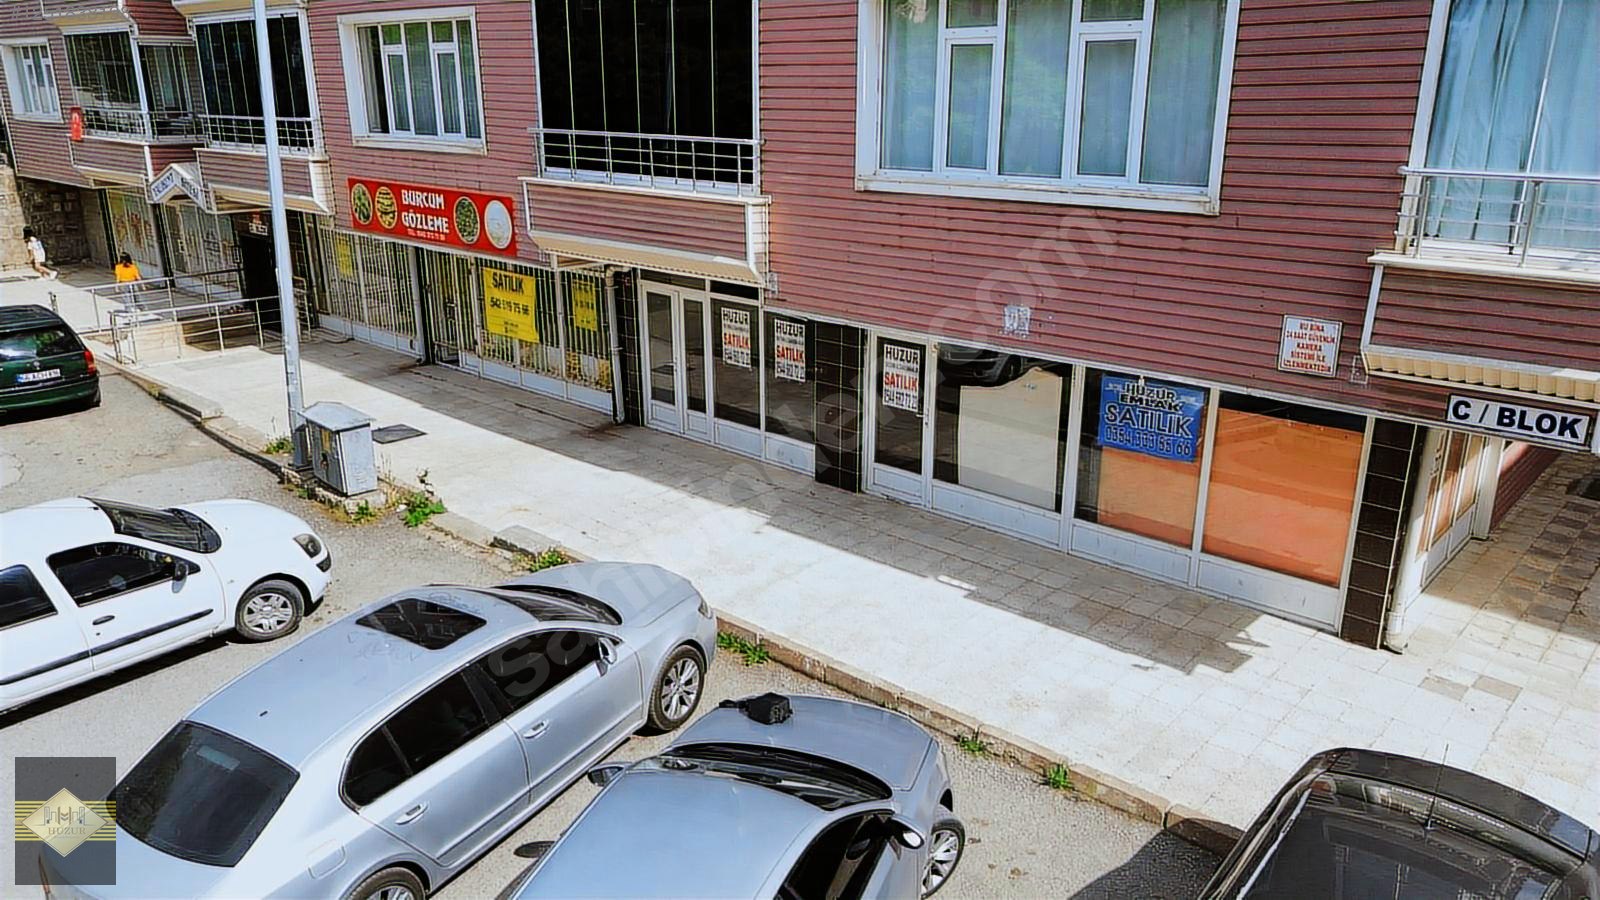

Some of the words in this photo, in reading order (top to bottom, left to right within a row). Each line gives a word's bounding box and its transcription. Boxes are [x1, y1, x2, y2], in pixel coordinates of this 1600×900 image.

[401, 189, 445, 210] BURCUM
[401, 209, 449, 233] GÖZLEME
[492, 272, 524, 294] SATILIK
[723, 309, 749, 325] HUZUR
[776, 321, 804, 338] HUZUR
[776, 344, 804, 363] SATILIK
[885, 346, 919, 365] HUZUR
[884, 372, 918, 392] SATILIK
[1124, 382, 1176, 402] HUZUR
[1119, 393, 1184, 414] EMLAK
[1105, 403, 1194, 438] SATILIK
[1452, 400, 1471, 420] C
[1478, 403, 1489, 423] /
[1496, 406, 1583, 439] BLOK
